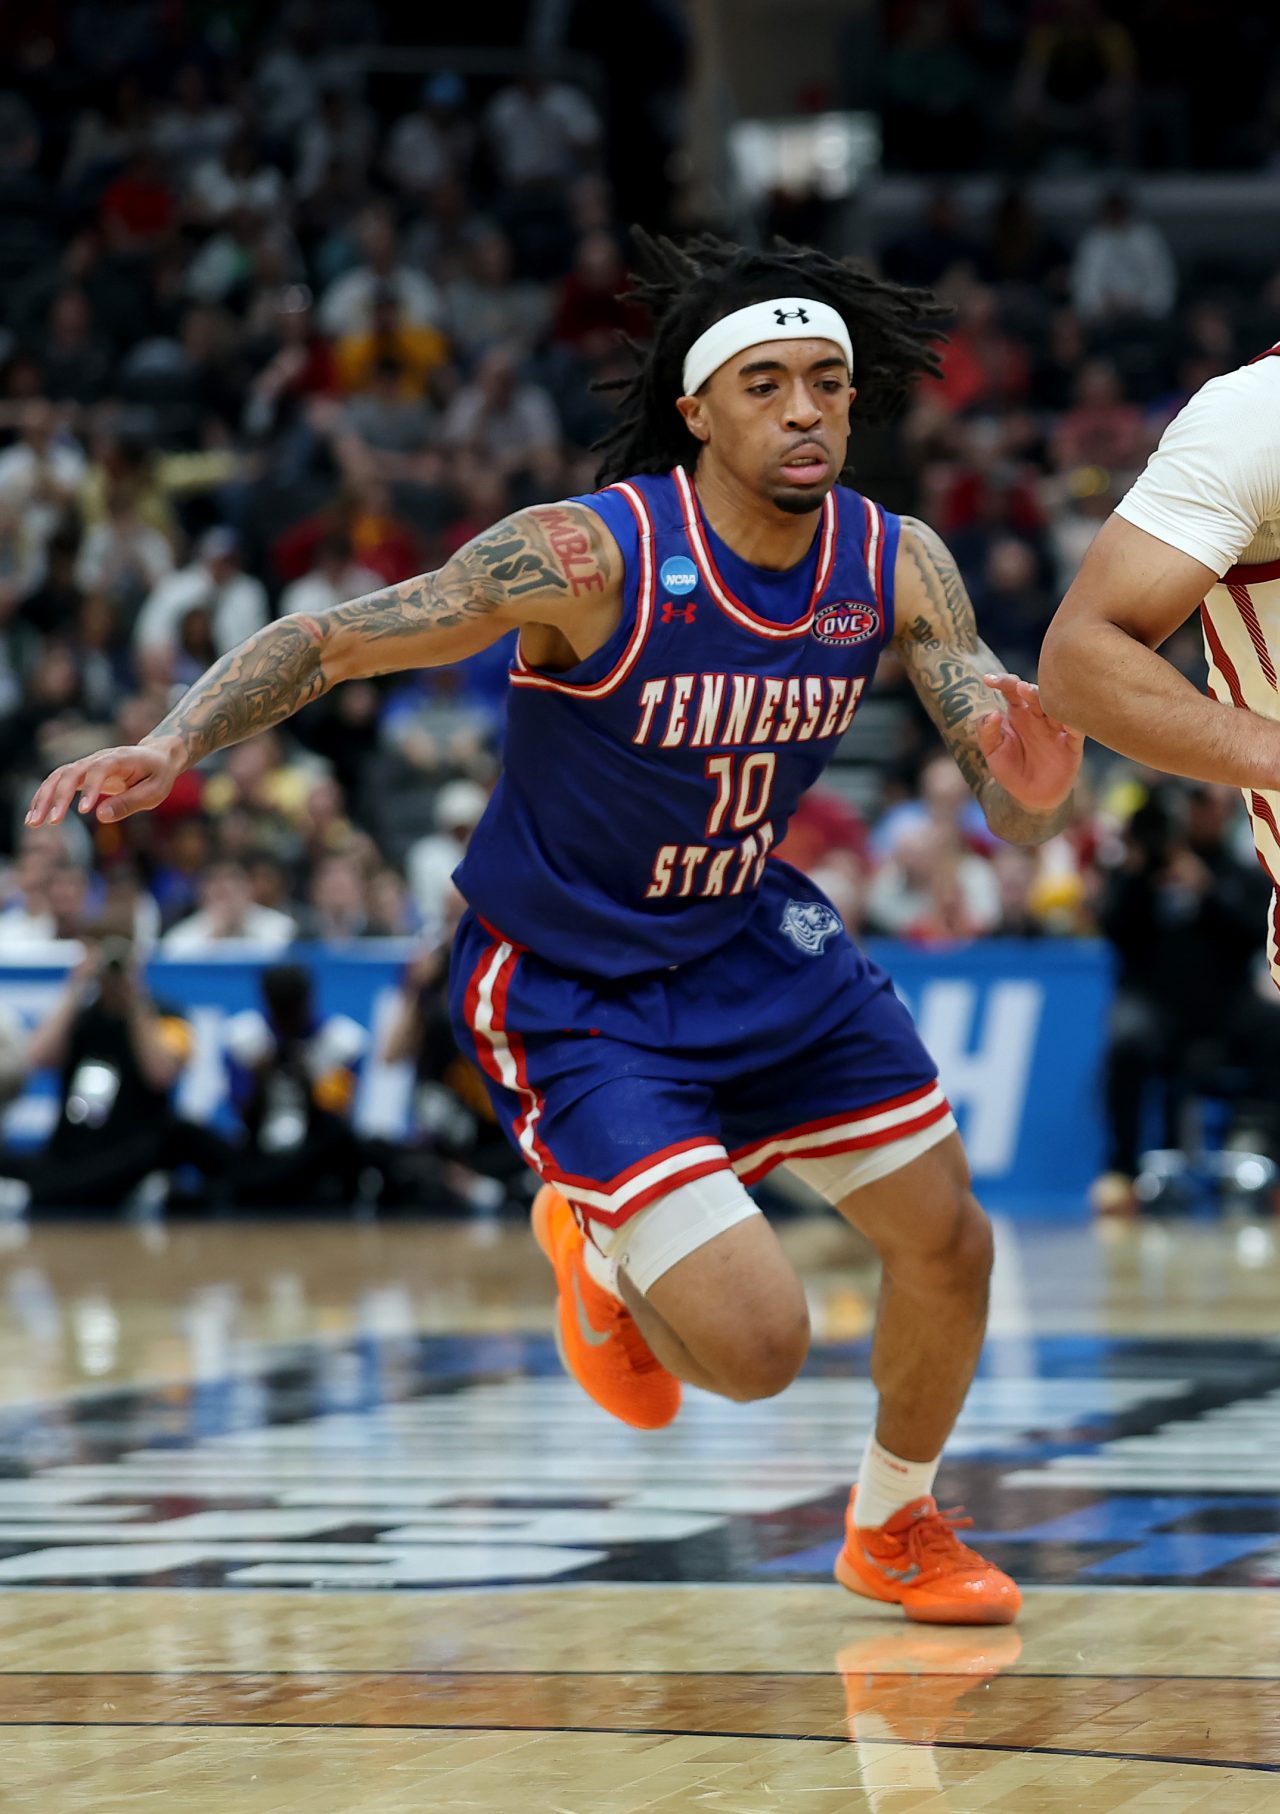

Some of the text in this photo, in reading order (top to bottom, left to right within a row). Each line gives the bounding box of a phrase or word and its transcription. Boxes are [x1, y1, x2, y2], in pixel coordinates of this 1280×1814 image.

[665, 573, 698, 586] NCAA
[823, 613, 864, 635] OVC
[632, 673, 867, 748] TENNESSEE
[704, 752, 777, 839] 10
[644, 820, 775, 899] STATE
